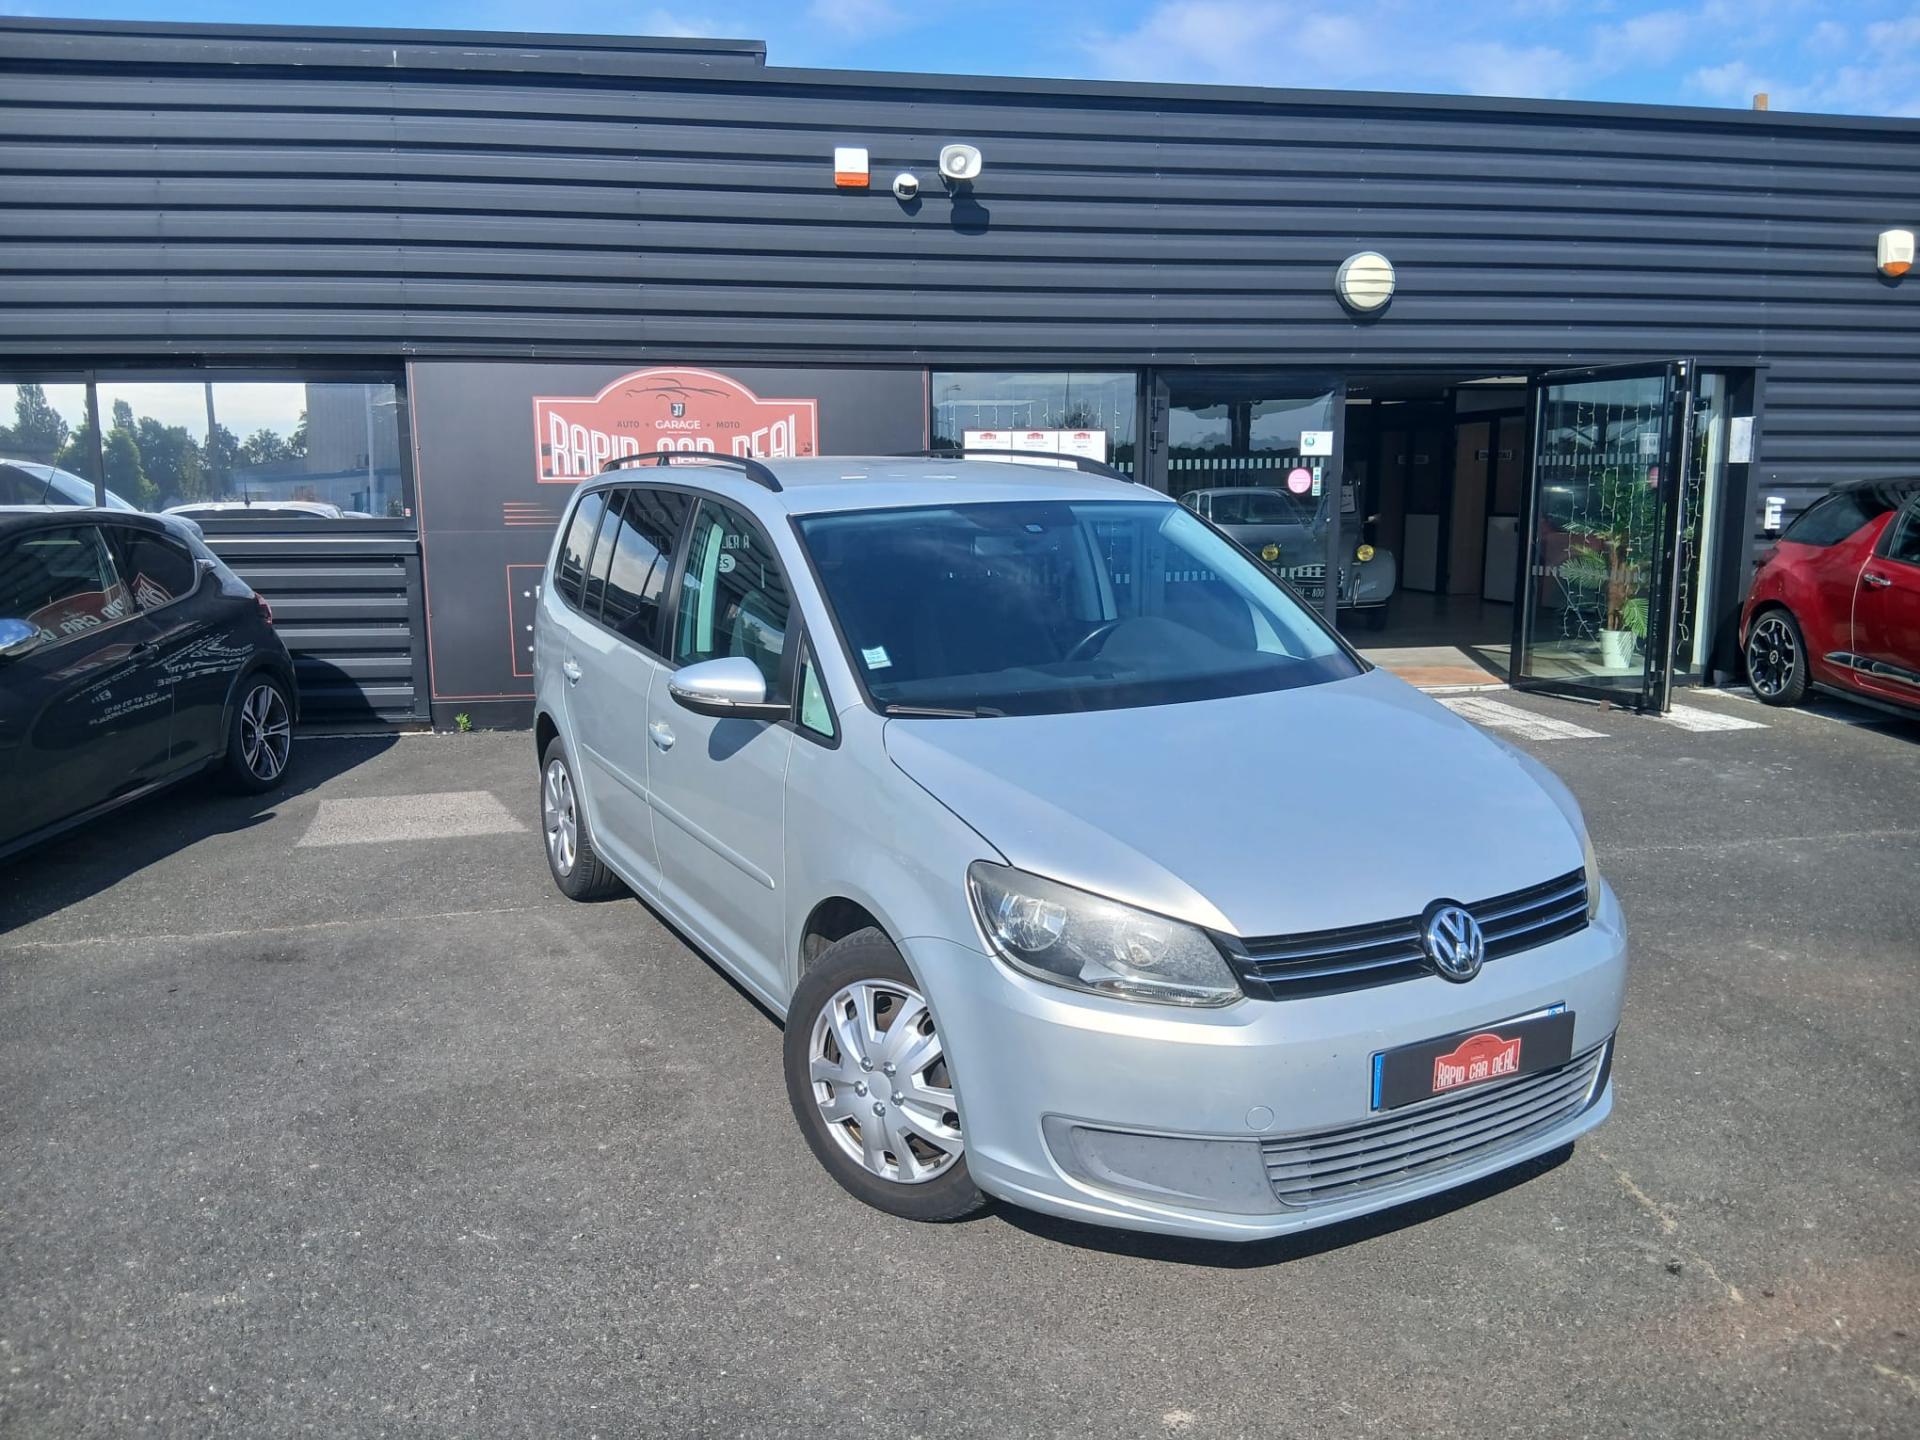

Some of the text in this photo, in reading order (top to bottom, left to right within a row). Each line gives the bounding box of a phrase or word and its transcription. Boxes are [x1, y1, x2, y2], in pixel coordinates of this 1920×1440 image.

[549, 411, 640, 476] RAPID
[655, 420, 701, 430] GARAGE
[1437, 1043, 1515, 1089] RAPID CAR DEAL
